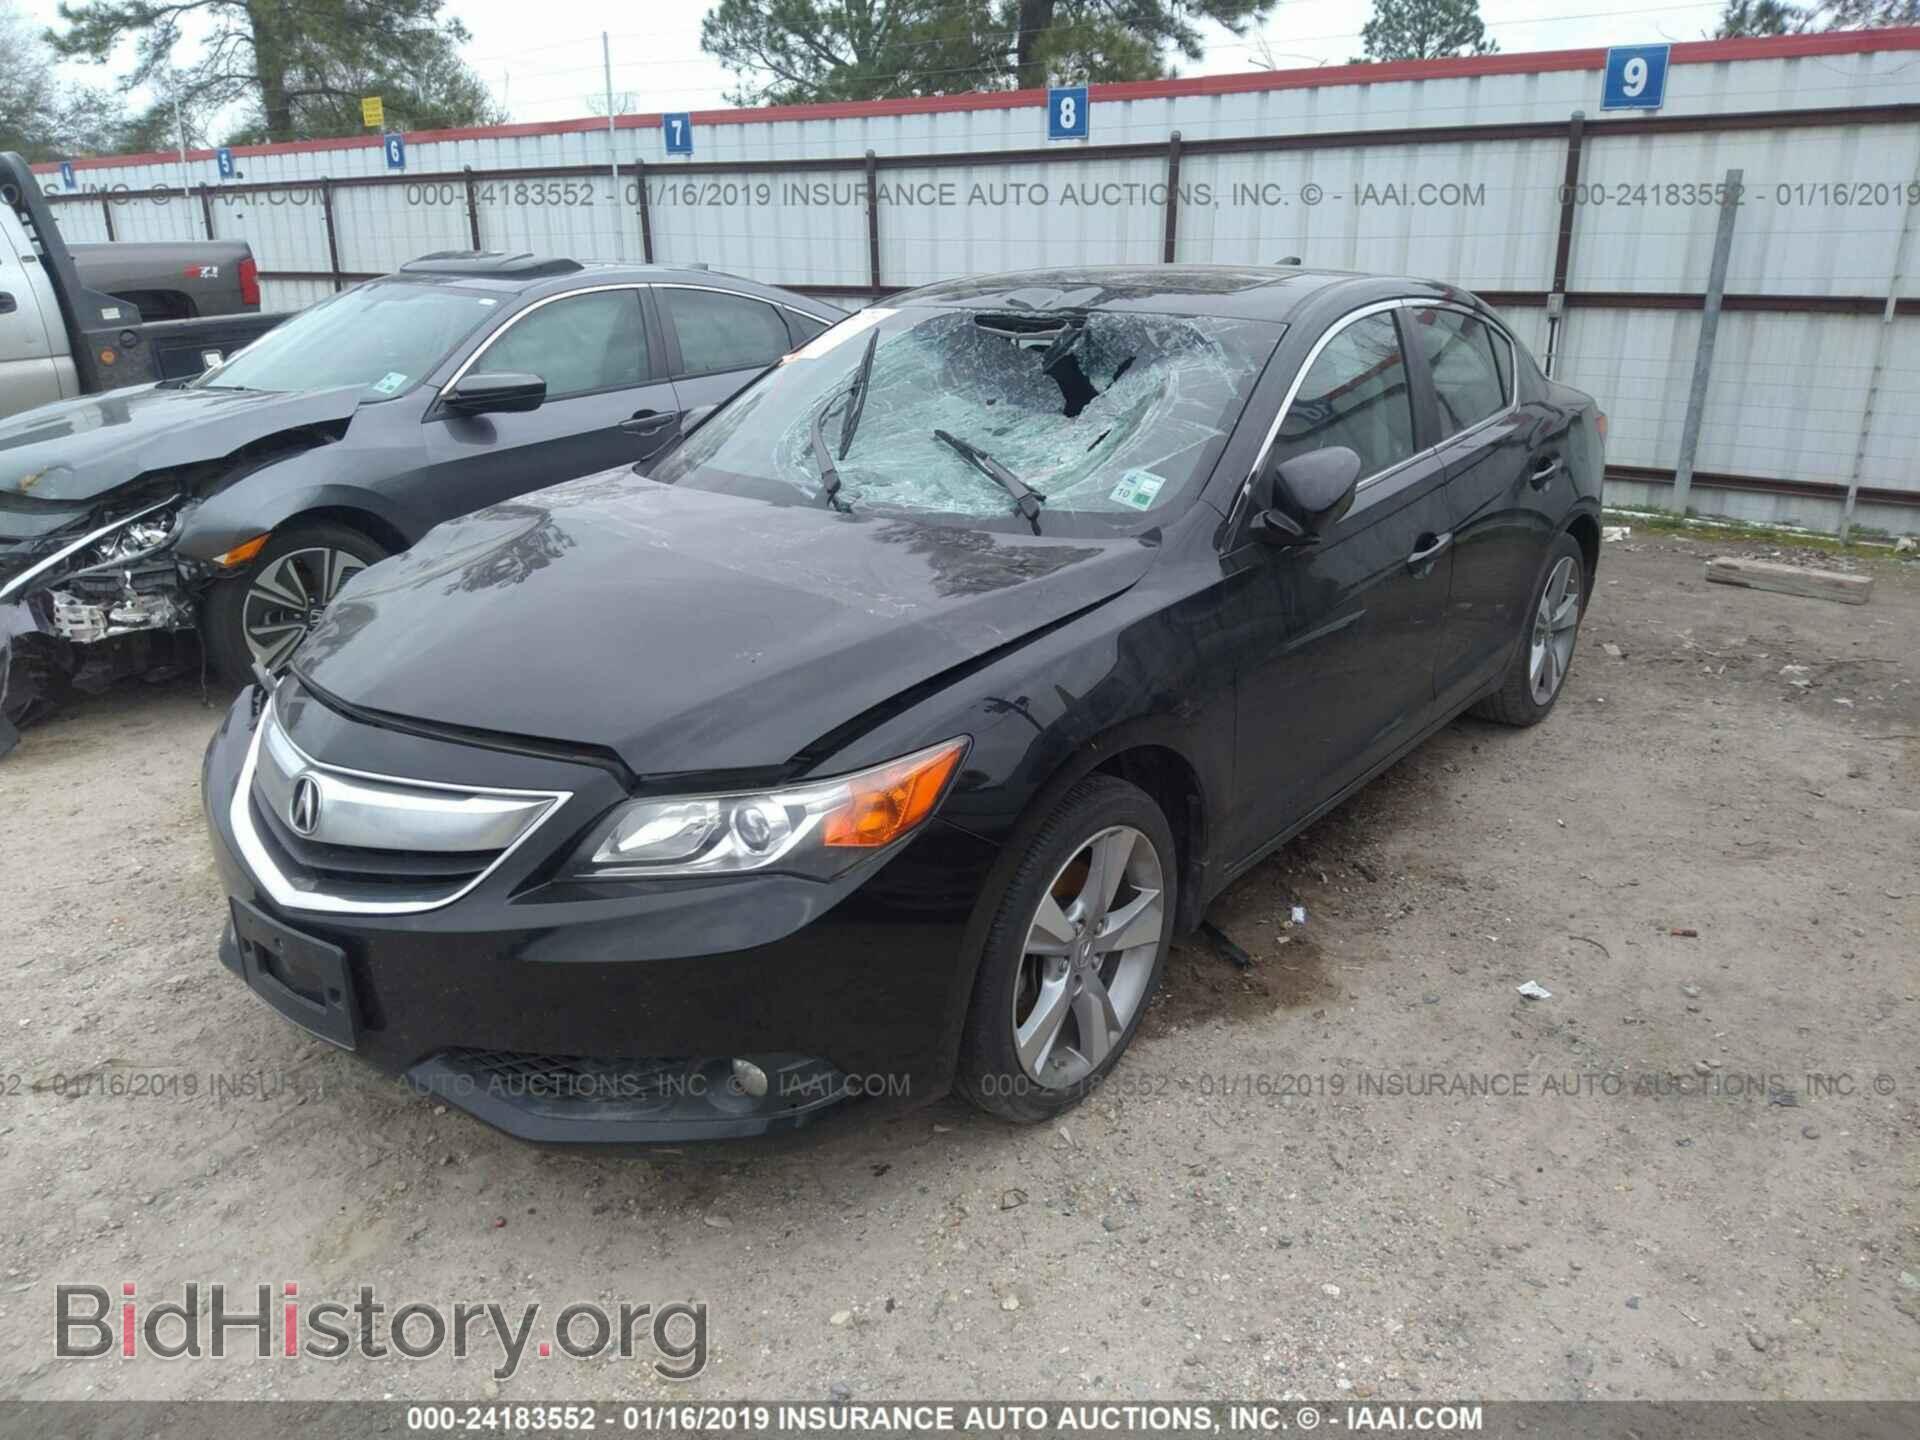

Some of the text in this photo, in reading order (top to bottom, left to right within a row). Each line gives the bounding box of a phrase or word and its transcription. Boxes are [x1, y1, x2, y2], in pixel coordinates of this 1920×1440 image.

[1622, 57, 1648, 97] 9
[1060, 96, 1076, 129] 8
[671, 120, 682, 146] 7
[220, 153, 230, 173] 5
[390, 140, 400, 162] 6
